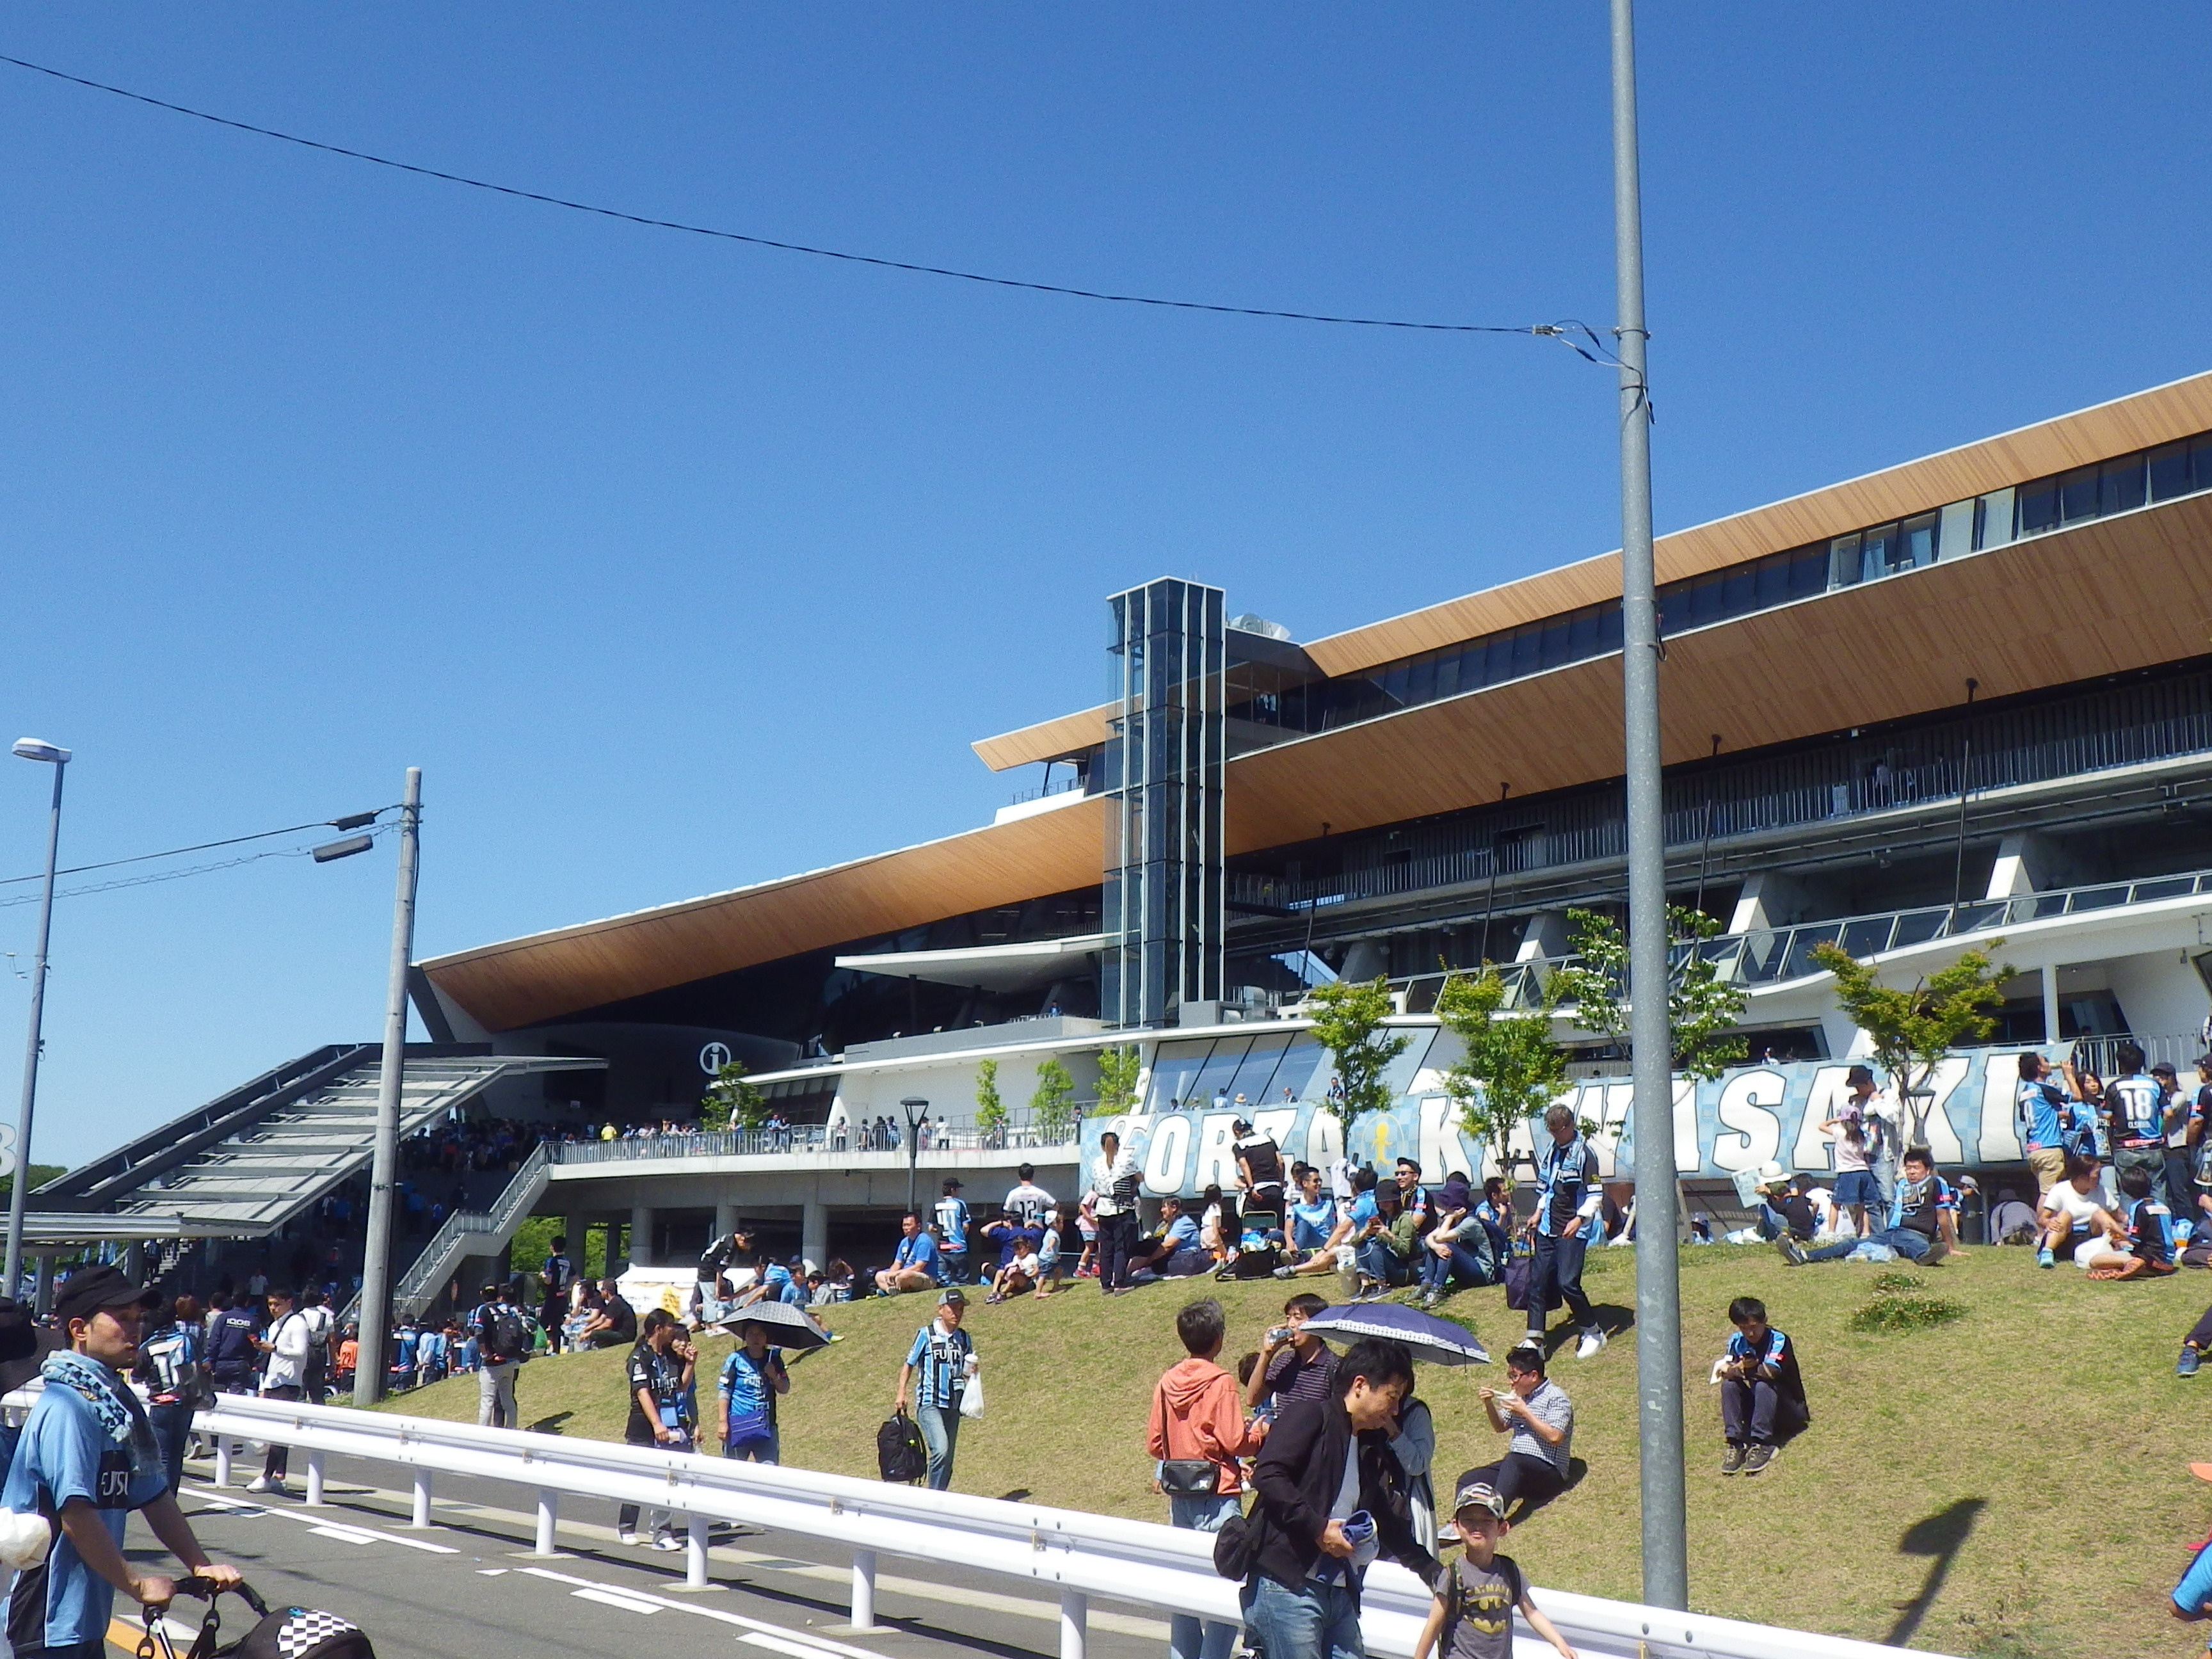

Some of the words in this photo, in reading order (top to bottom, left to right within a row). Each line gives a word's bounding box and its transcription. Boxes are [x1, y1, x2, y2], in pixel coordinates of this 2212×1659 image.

[2120, 1089, 2152, 1120] 18
[1105, 1104, 1345, 1196] FORZA
[1018, 1200, 1037, 1219] 12
[226, 1317, 251, 1327] IQOS
